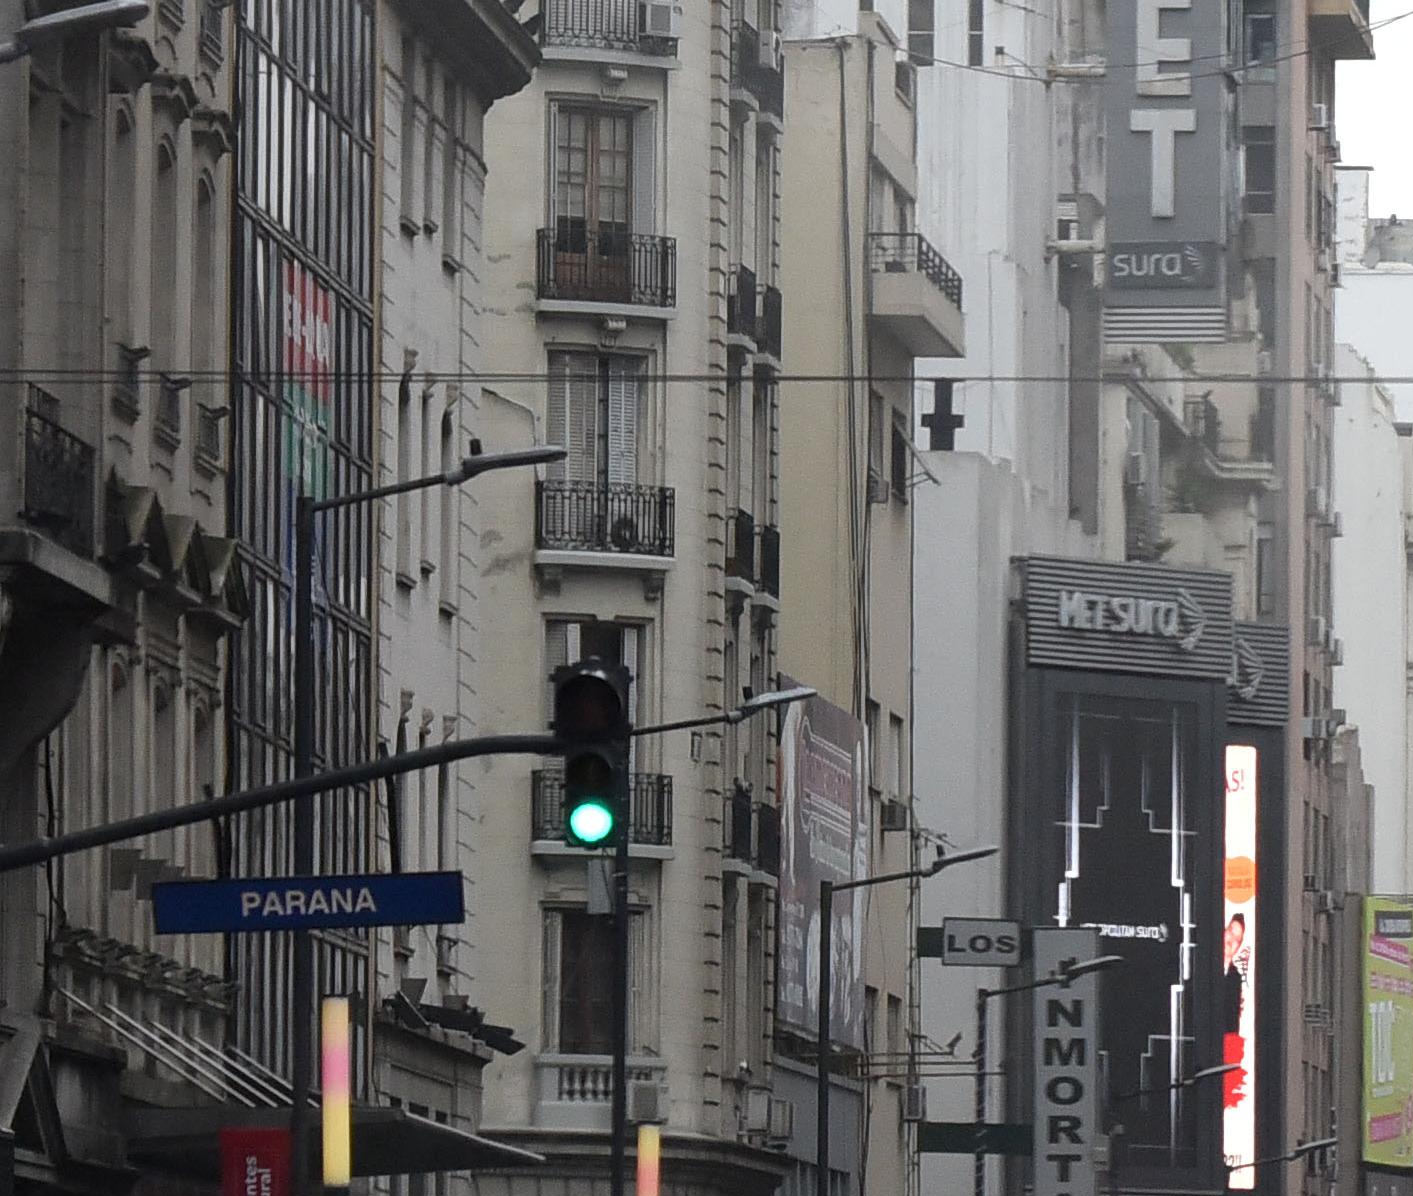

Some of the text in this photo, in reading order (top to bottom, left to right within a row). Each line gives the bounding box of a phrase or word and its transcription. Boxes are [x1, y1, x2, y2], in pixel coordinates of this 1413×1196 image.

[1113, 252, 1183, 276] sura
[1110, 597, 1179, 637] sura
[241, 887, 378, 919] PARANA
[947, 933, 1019, 954] LOS
